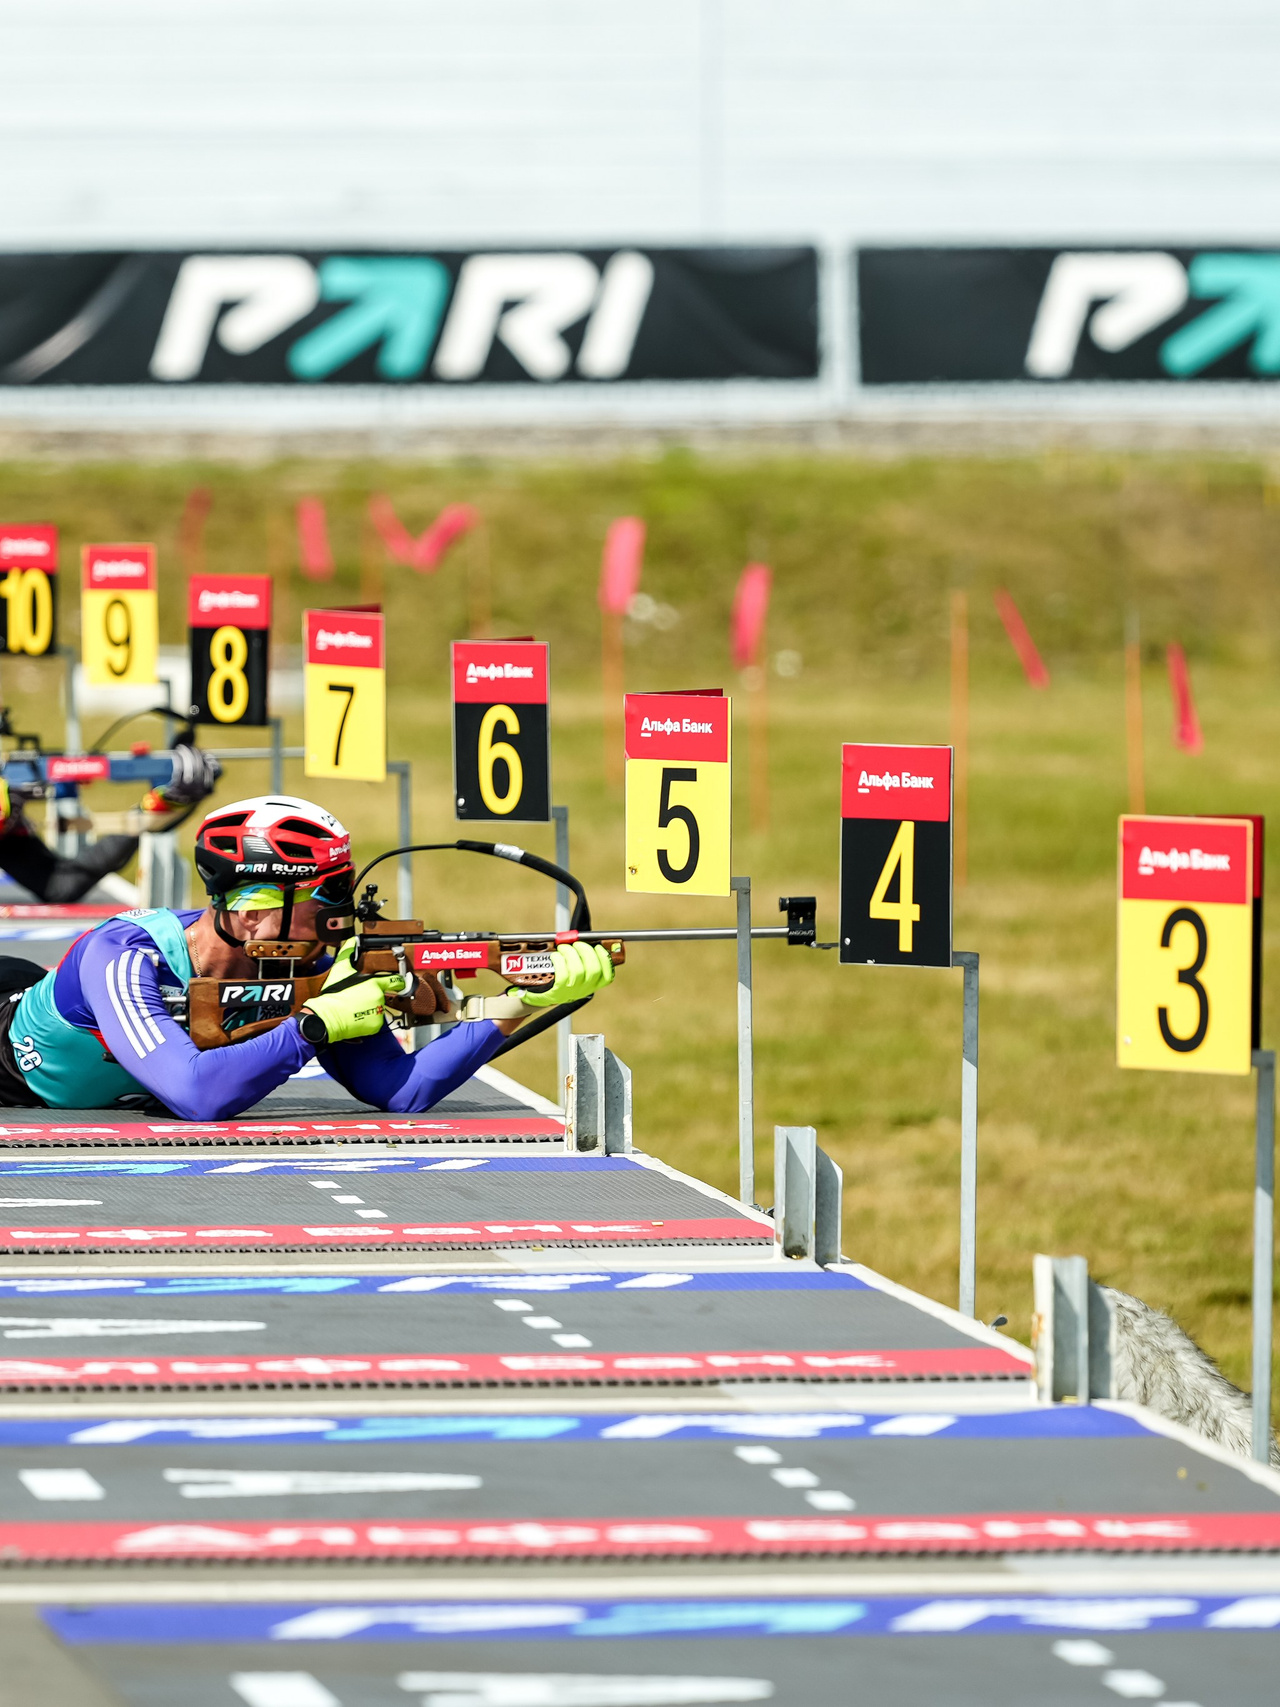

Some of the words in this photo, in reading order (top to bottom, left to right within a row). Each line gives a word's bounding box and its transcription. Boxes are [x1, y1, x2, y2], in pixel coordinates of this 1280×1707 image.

[150, 250, 654, 381] PARI
[1024, 251, 1280, 378] PA
[105, 598, 132, 677] 9
[207, 625, 249, 723] 8
[466, 664, 503, 682] Альфа
[504, 664, 533, 679] Банк
[329, 683, 354, 766] 7
[641, 717, 680, 737] Альфа
[682, 719, 713, 734] Банк
[478, 704, 523, 815] 6
[858, 770, 900, 793] Альфа
[902, 772, 934, 789] Банк
[656, 767, 700, 884] 5
[235, 863, 268, 873] PARI
[272, 863, 319, 873] RUDY
[1138, 846, 1190, 875] Альфа
[1190, 848, 1231, 872] Банк
[869, 820, 920, 953] 4
[422, 950, 455, 963] Альфа
[456, 950, 482, 960] Банк
[221, 983, 292, 1004] PARI
[1157, 907, 1210, 1053] 3
[12, 1035, 43, 1072] 26
[147, 1123, 460, 1133] Банк
[303, 1225, 652, 1237] Банк
[500, 1354, 896, 1370] Банк
[67, 1414, 958, 1443] PARI
[115, 1524, 713, 1553] Альфа
[745, 1520, 1196, 1542] Банк
